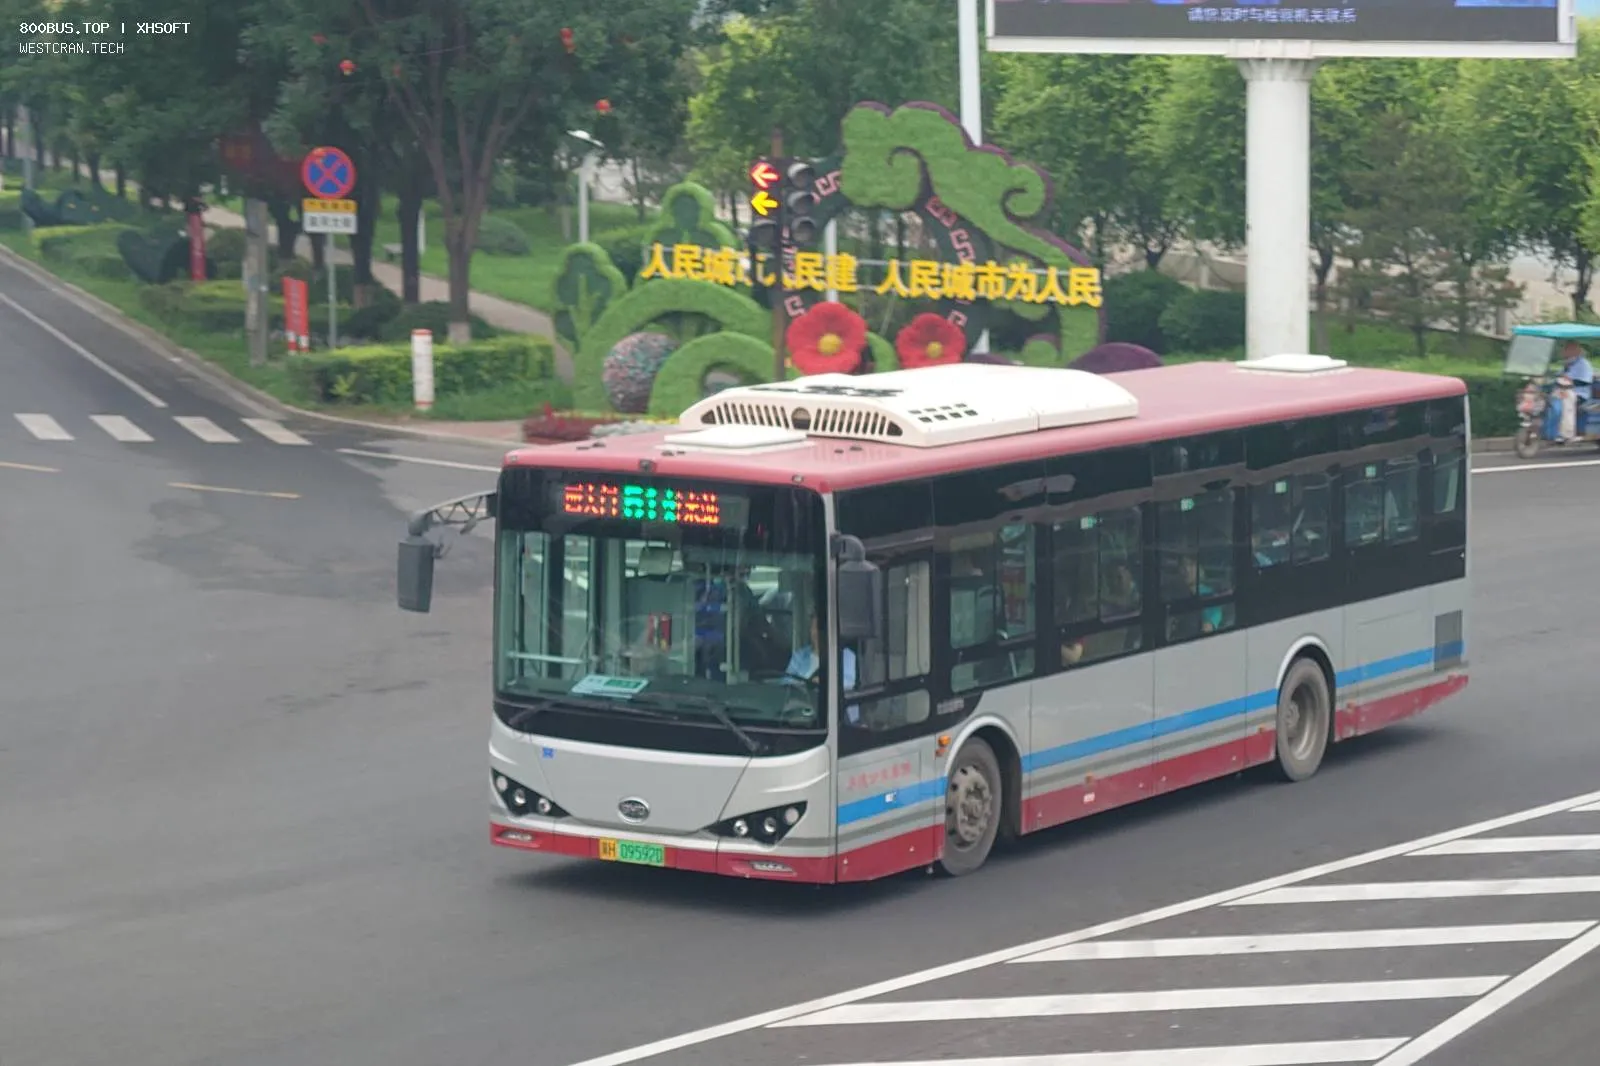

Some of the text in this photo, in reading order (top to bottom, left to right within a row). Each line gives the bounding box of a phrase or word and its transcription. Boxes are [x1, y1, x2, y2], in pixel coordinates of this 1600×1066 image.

[875, 259, 1104, 308] 人民城市为人民
